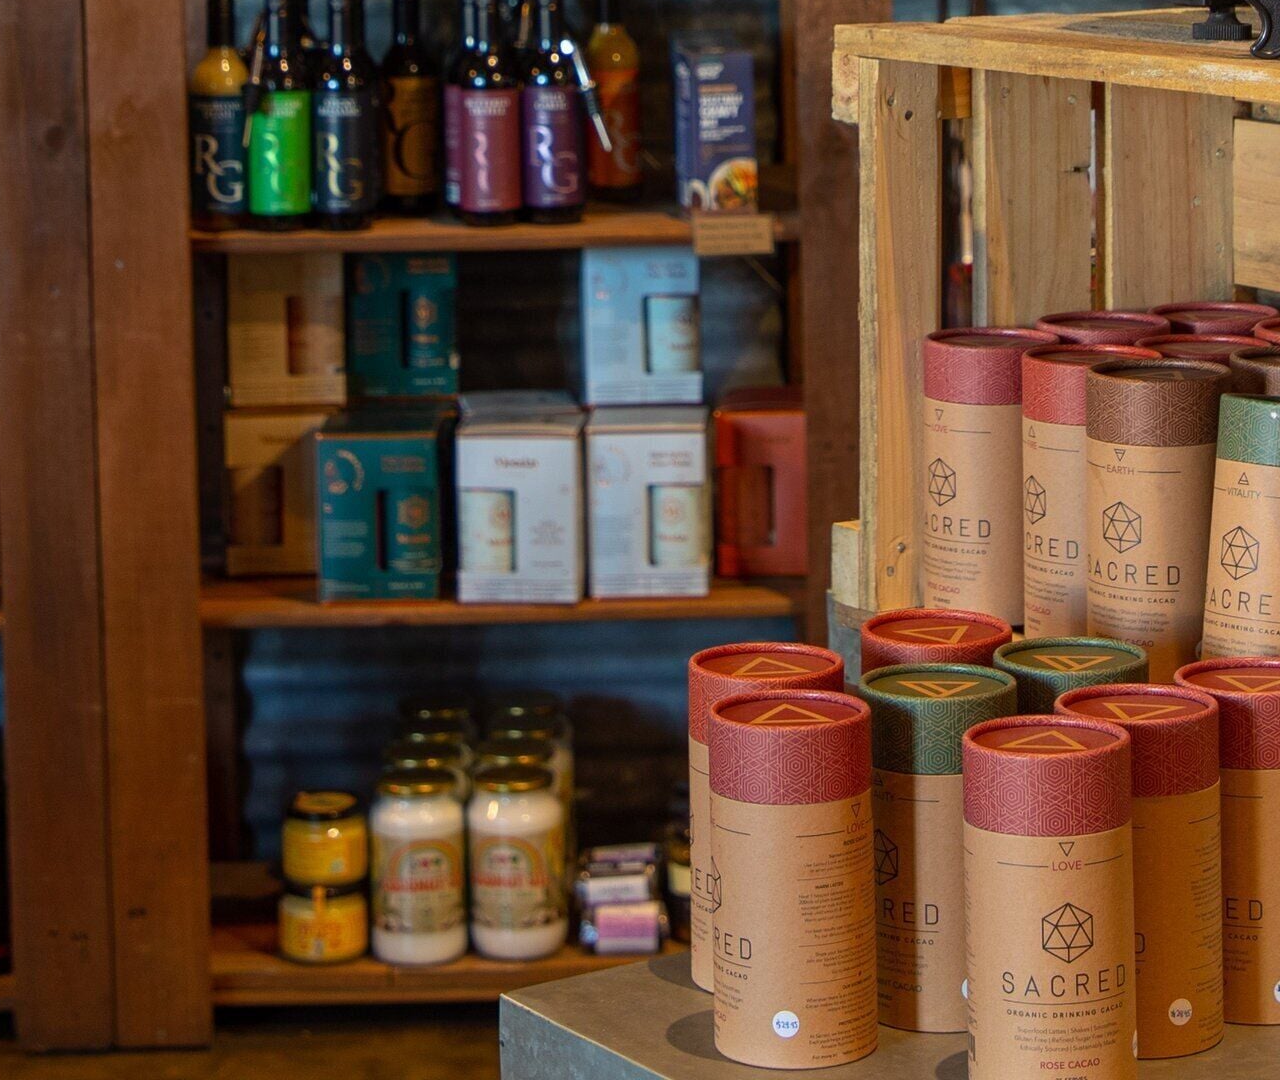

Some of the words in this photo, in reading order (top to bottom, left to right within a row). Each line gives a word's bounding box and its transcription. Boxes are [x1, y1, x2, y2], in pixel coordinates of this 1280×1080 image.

[1106, 464, 1135, 475] EARTH
[1227, 487, 1261, 499] VITALITY
[960, 547, 987, 556] CACAO
[1025, 531, 1079, 560] CRED
[1108, 592, 1144, 604] DRINKING
[1148, 597, 1176, 605] CACAO
[1220, 621, 1255, 634] DRINKING
[847, 821, 866, 835] LOVE
[1052, 860, 1082, 871] LOVE
[904, 935, 934, 945] CACAO
[1228, 933, 1258, 941] CACAO
[725, 970, 748, 981] CACAO
[1002, 963, 1126, 998] SACRED
[892, 980, 923, 993] CACAO
[1006, 1008, 1048, 1019] ORGANIC
[1052, 1008, 1096, 1019] DRINKING
[1100, 1002, 1124, 1014] CACAO
[1017, 1025, 1047, 1036] Superfood
[1048, 1025, 1066, 1035] Lattes
[1070, 1024, 1090, 1034] Shakes
[1014, 1034, 1032, 1044] Gluten
[1034, 1035, 1048, 1044] Free
[1052, 1035, 1073, 1044] Refined
[1020, 1044, 1044, 1054] Ethically
[1045, 1045, 1069, 1053] Sourced
[1040, 1061, 1064, 1070] ROSE
[1067, 1058, 1100, 1070] CACAO
